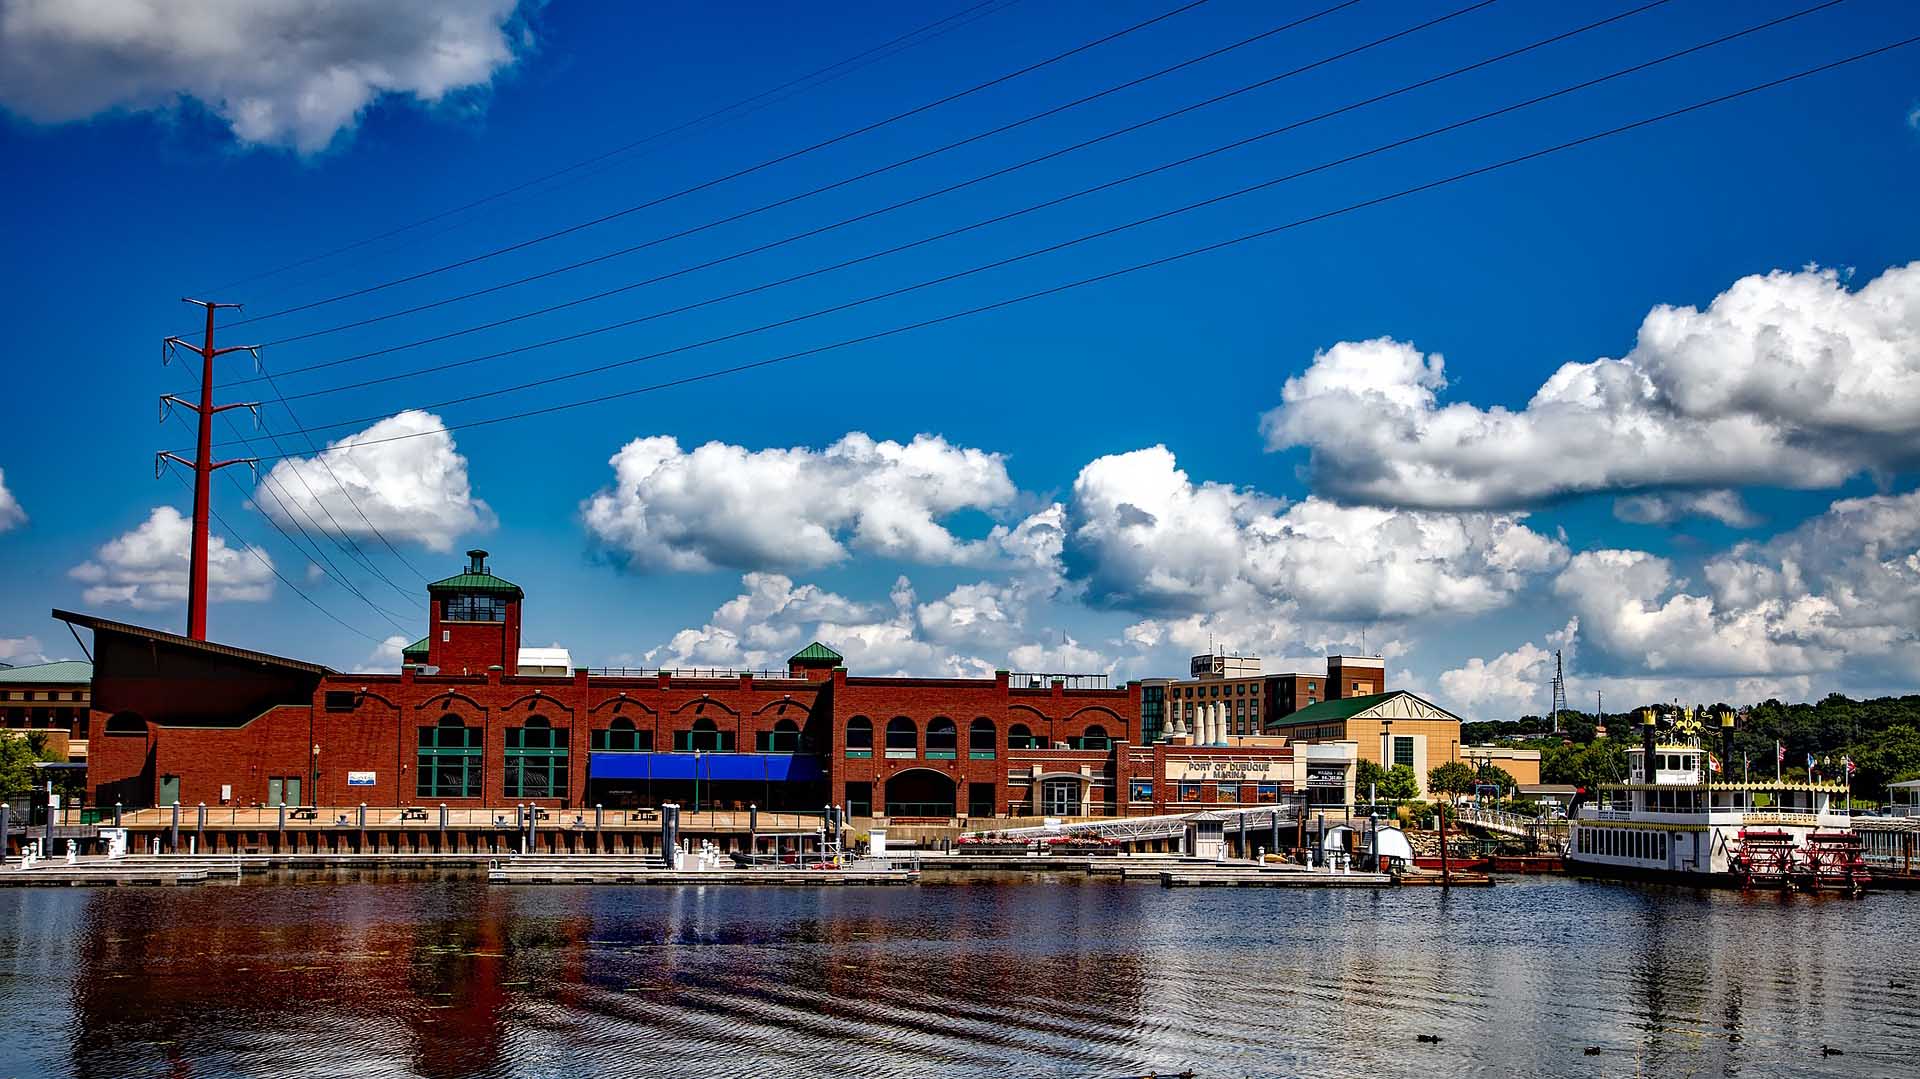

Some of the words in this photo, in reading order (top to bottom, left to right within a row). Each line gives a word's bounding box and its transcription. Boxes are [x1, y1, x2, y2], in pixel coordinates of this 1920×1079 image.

[1189, 763, 1211, 771] PORT
[1215, 763, 1226, 771] OF
[1229, 763, 1270, 771] DUBUQUE
[1213, 771, 1246, 779] MARINA
[1782, 814, 1817, 822] DUBUQUE
